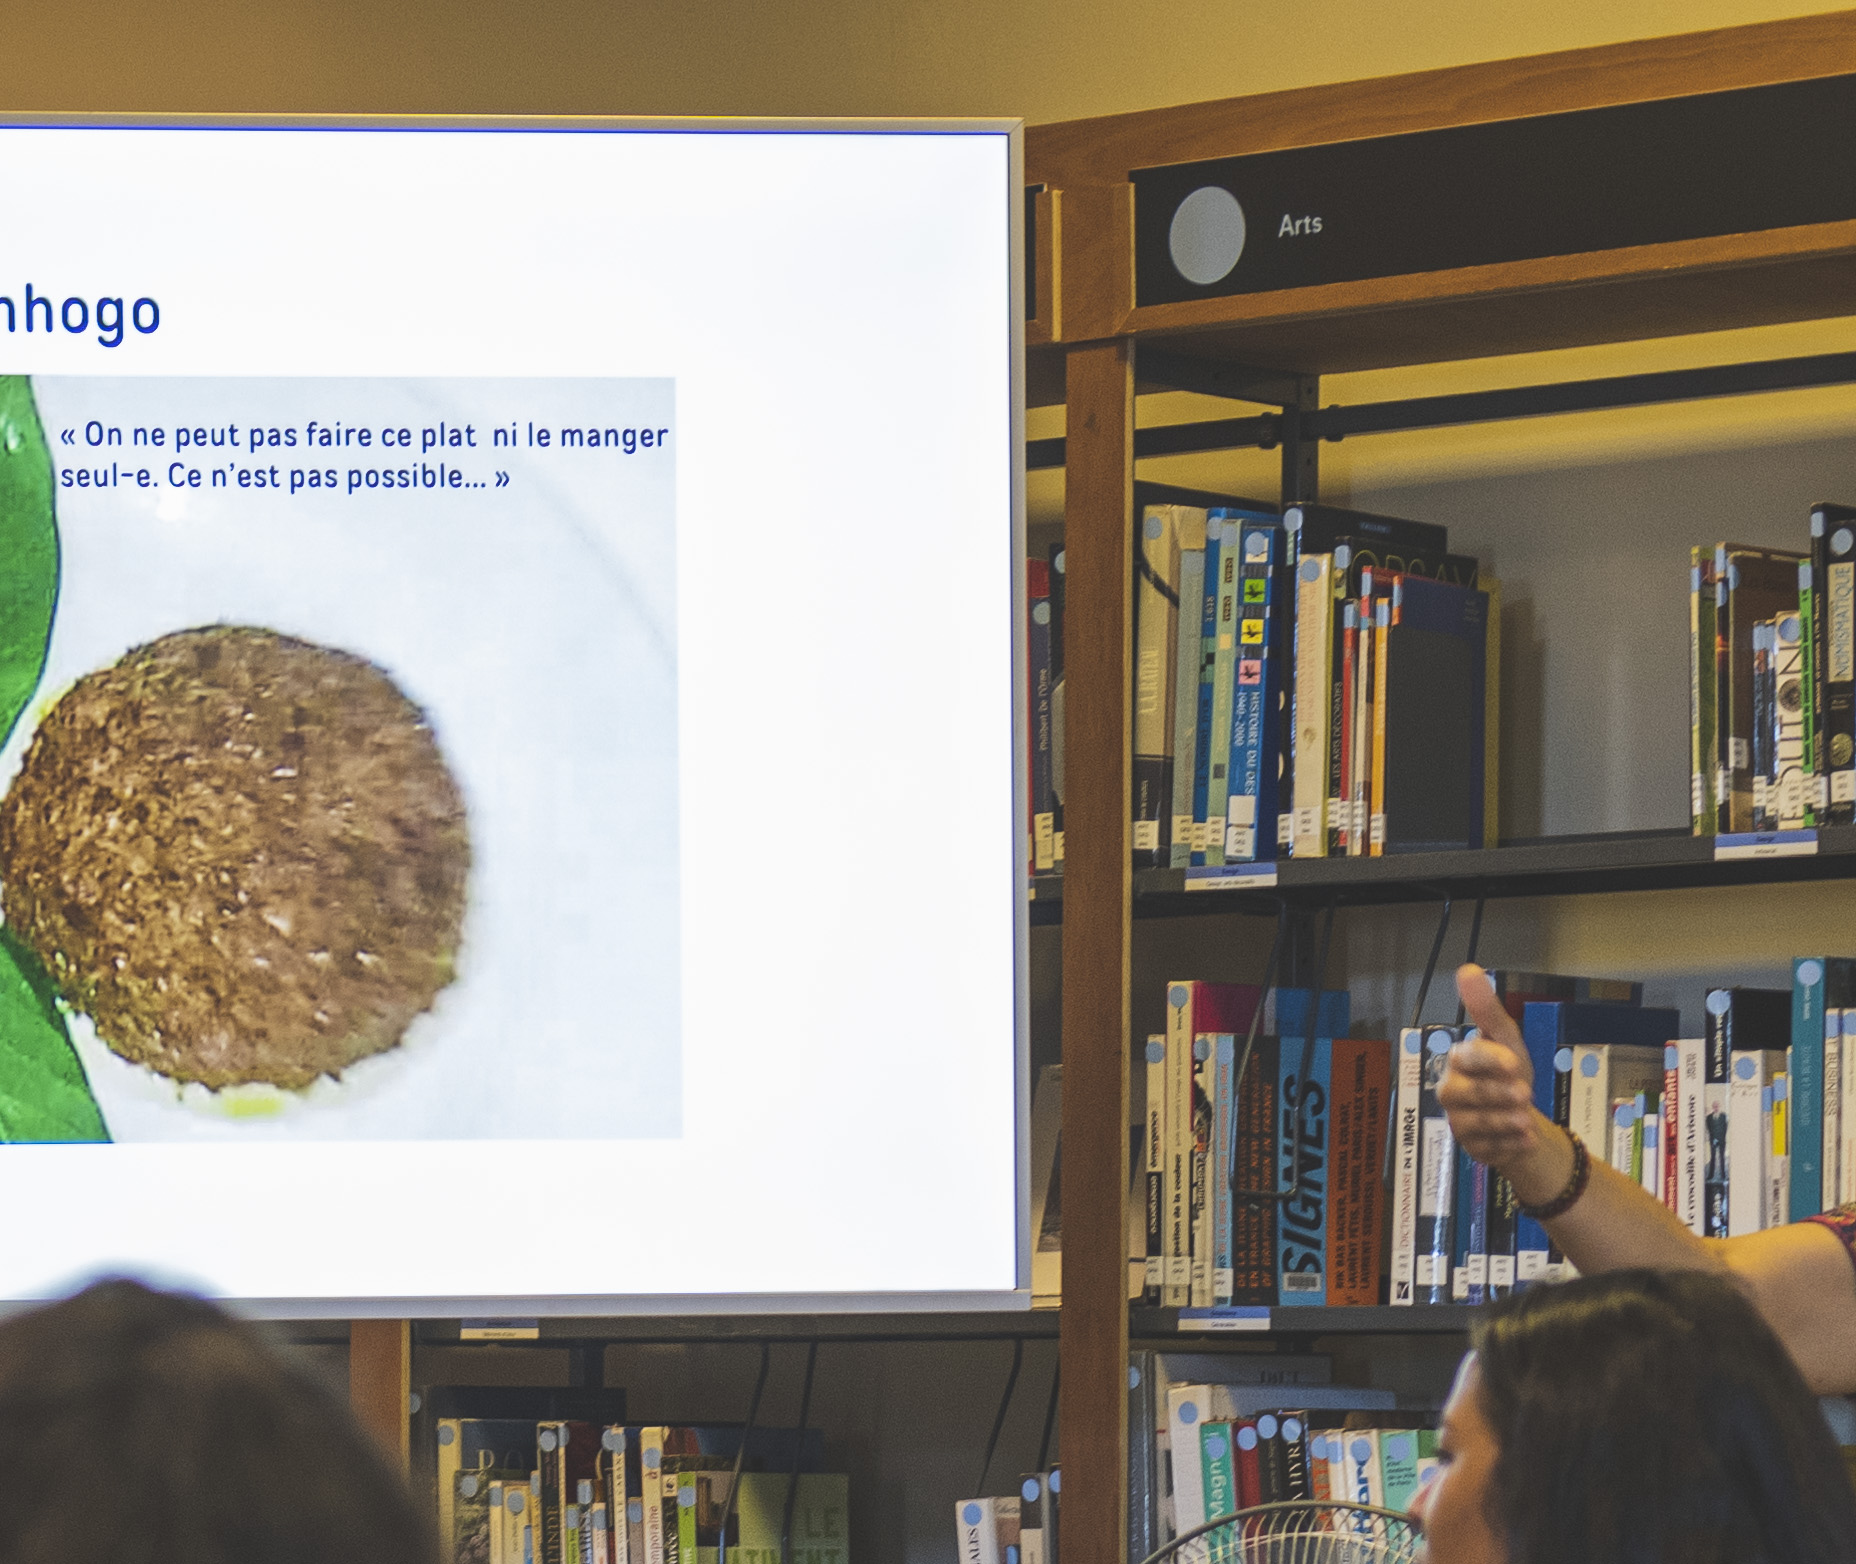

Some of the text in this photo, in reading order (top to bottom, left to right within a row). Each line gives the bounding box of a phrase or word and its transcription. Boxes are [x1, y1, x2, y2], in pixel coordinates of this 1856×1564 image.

[1278, 214, 1322, 238] Arts
[85, 420, 122, 447] On
[133, 427, 166, 447] ne
[175, 423, 240, 454] peut
[249, 427, 297, 454] pas
[306, 421, 372, 447] faire
[381, 427, 412, 447] ce
[421, 421, 477, 455] plat
[493, 421, 517, 447] ni
[528, 421, 551, 447] le
[561, 428, 669, 455] manger
[60, 462, 158, 488] seul-e.
[168, 461, 202, 488] Ce
[212, 462, 281, 488] n'est
[290, 469, 338, 495] pas
[347, 462, 486, 496] possible...
[1832, 566, 1853, 679] NUMISMATIQUE
[1664, 1069, 1677, 1124] enfants
[1282, 1073, 1325, 1274] SIGNES
[1400, 1172, 1414, 1249] DICTIONNAIRE
[807, 1507, 841, 1539] LE
